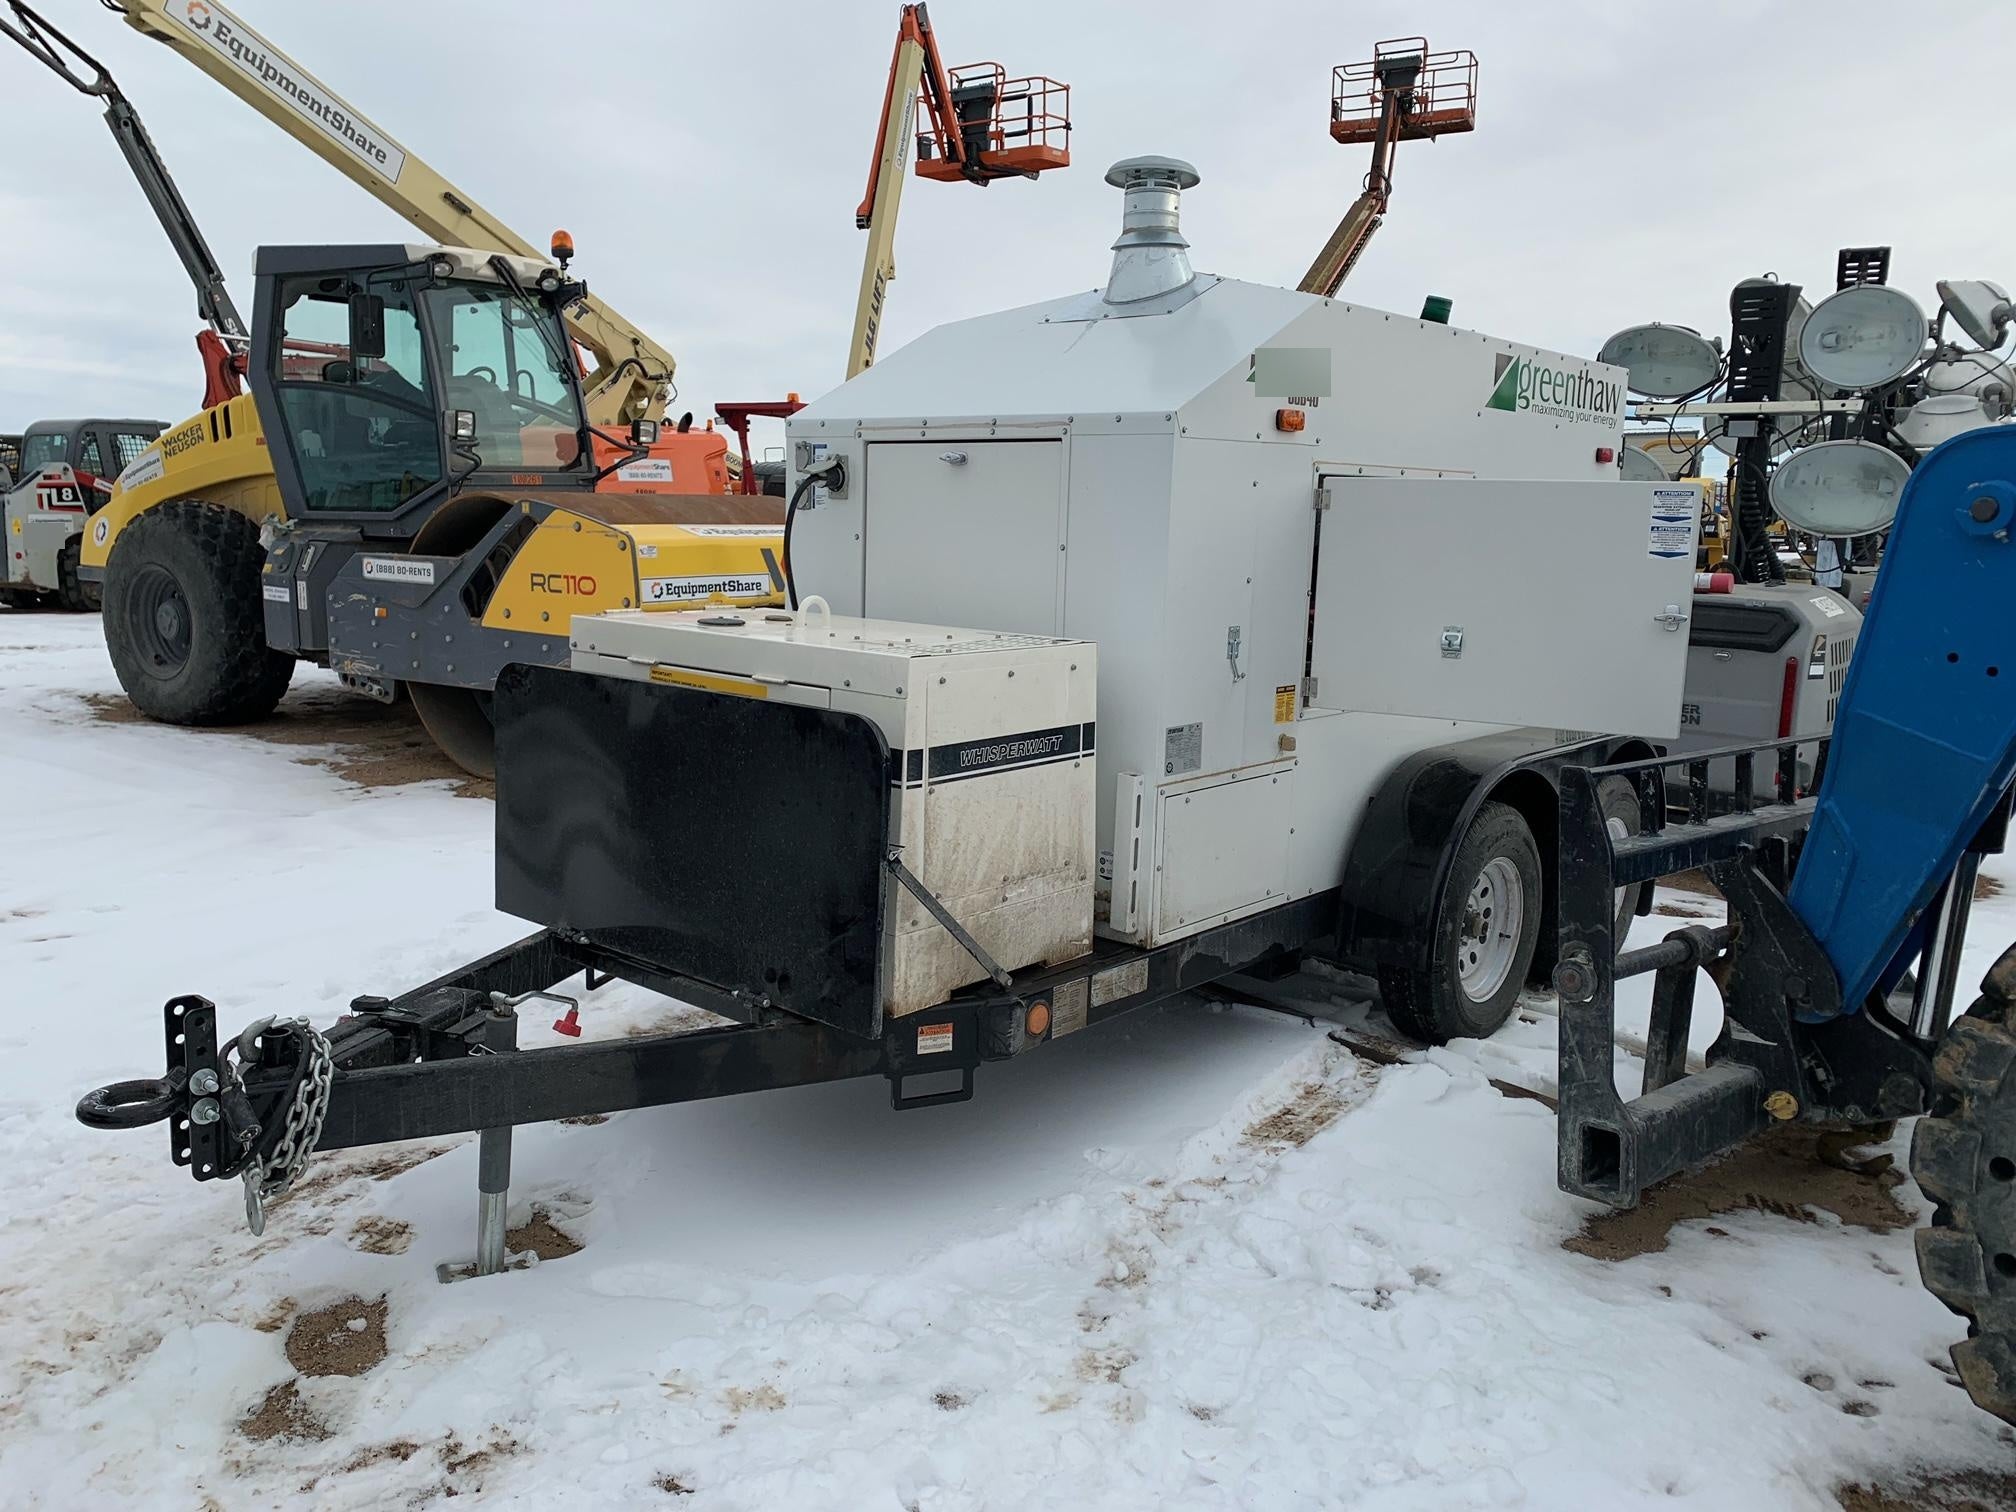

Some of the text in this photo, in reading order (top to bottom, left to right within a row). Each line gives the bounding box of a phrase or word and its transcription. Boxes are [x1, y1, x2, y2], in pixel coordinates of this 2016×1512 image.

[213, 20, 387, 164] EquipmentShare
[865, 316, 876, 357] JLG
[871, 268, 884, 316] LIFT
[1518, 359, 1622, 415] greenthaw
[1532, 403, 1618, 429] maximizing your energy
[162, 423, 203, 448] WACKER
[164, 431, 205, 459] NEUSON
[376, 563, 395, 575] (888)
[530, 573, 596, 596] RC110
[665, 580, 763, 598] EquipmentShare
[960, 735, 1064, 767] WHISPERWATT
